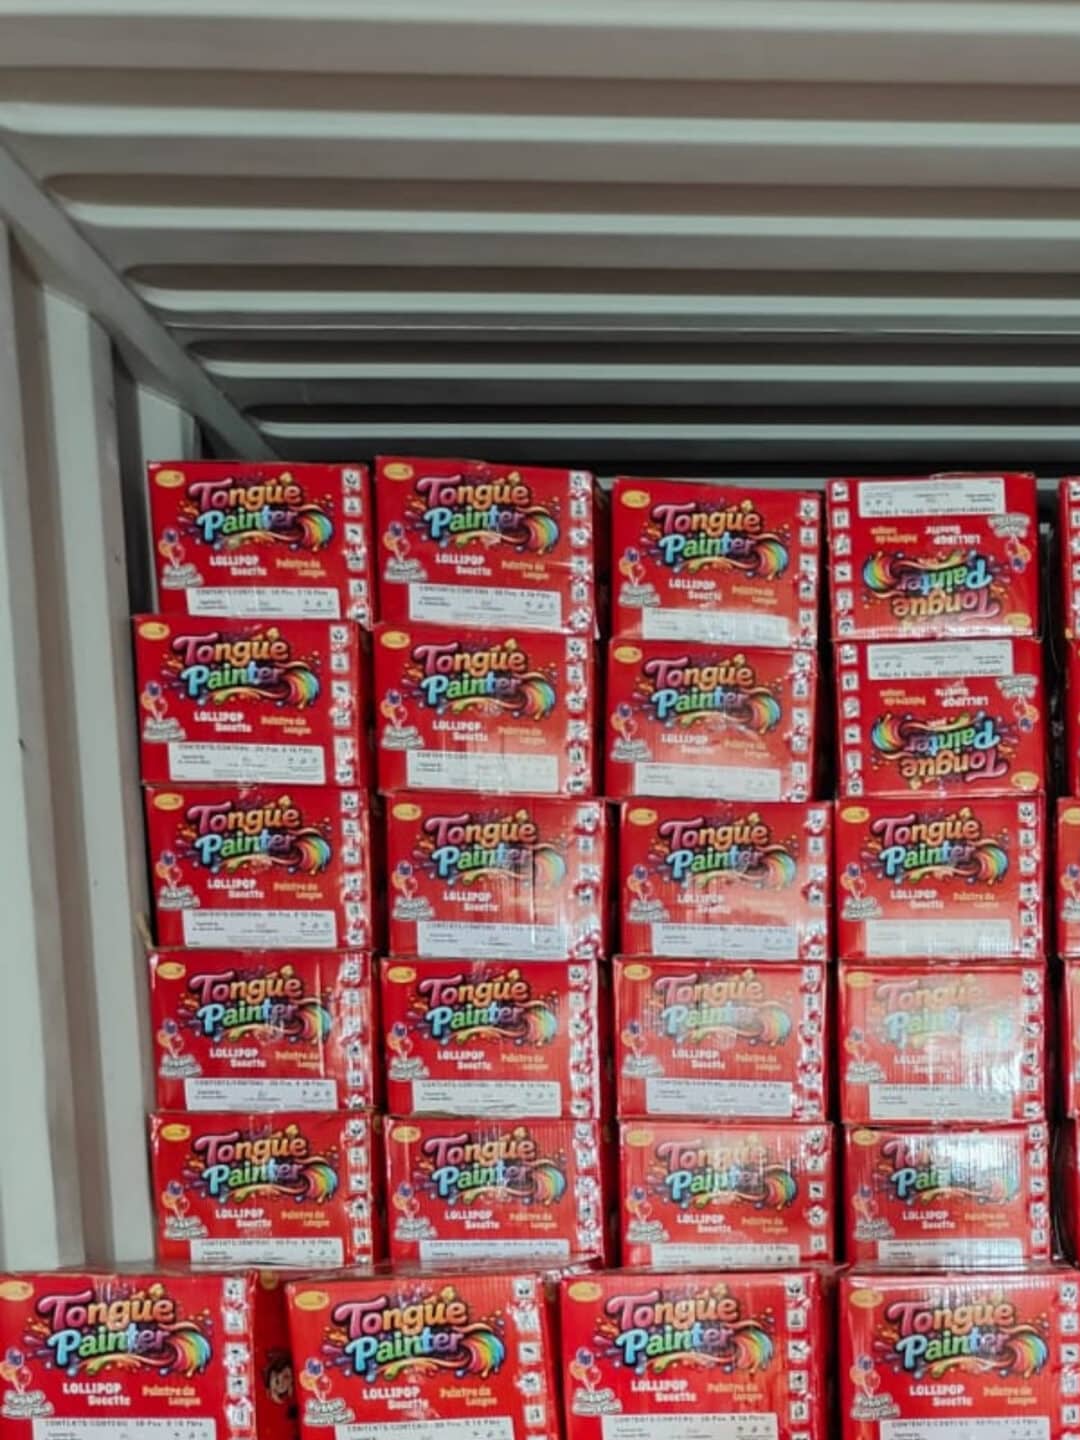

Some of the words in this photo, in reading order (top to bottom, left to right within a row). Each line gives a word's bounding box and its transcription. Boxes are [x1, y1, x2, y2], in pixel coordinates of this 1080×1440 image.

[188, 477, 301, 513] Tongue
[416, 474, 528, 512] Tongue
[197, 505, 298, 543] Painter
[424, 504, 525, 539] Painter
[895, 557, 992, 596] Painter
[892, 588, 1000, 623] Tongue
[172, 631, 287, 668] Tongue
[413, 642, 525, 678] Tongue
[182, 661, 284, 698] Painter
[422, 671, 522, 707] Painter
[904, 718, 1000, 756] Painter
[901, 749, 1008, 782] Tongue
[186, 801, 299, 836] Tongue
[873, 814, 979, 847] Tongue
[195, 829, 296, 866] Painter
[880, 840, 976, 877] Painter
[419, 974, 527, 1008] Tongue
[427, 1001, 524, 1037] Painter
[194, 1131, 307, 1165] Tongue
[203, 1158, 304, 1196] Painter
[38, 1290, 174, 1332] Tongue
[334, 1296, 466, 1336] Tongue
[607, 1290, 737, 1330] Tongue
[48, 1323, 170, 1367] Painter
[346, 1327, 464, 1373] Painter
[617, 1322, 734, 1365] Painter
[62, 1382, 123, 1395] LOLLIPOP
[362, 1386, 421, 1401] LOLLIPOP
[630, 1379, 689, 1393] LOLLIPOP
